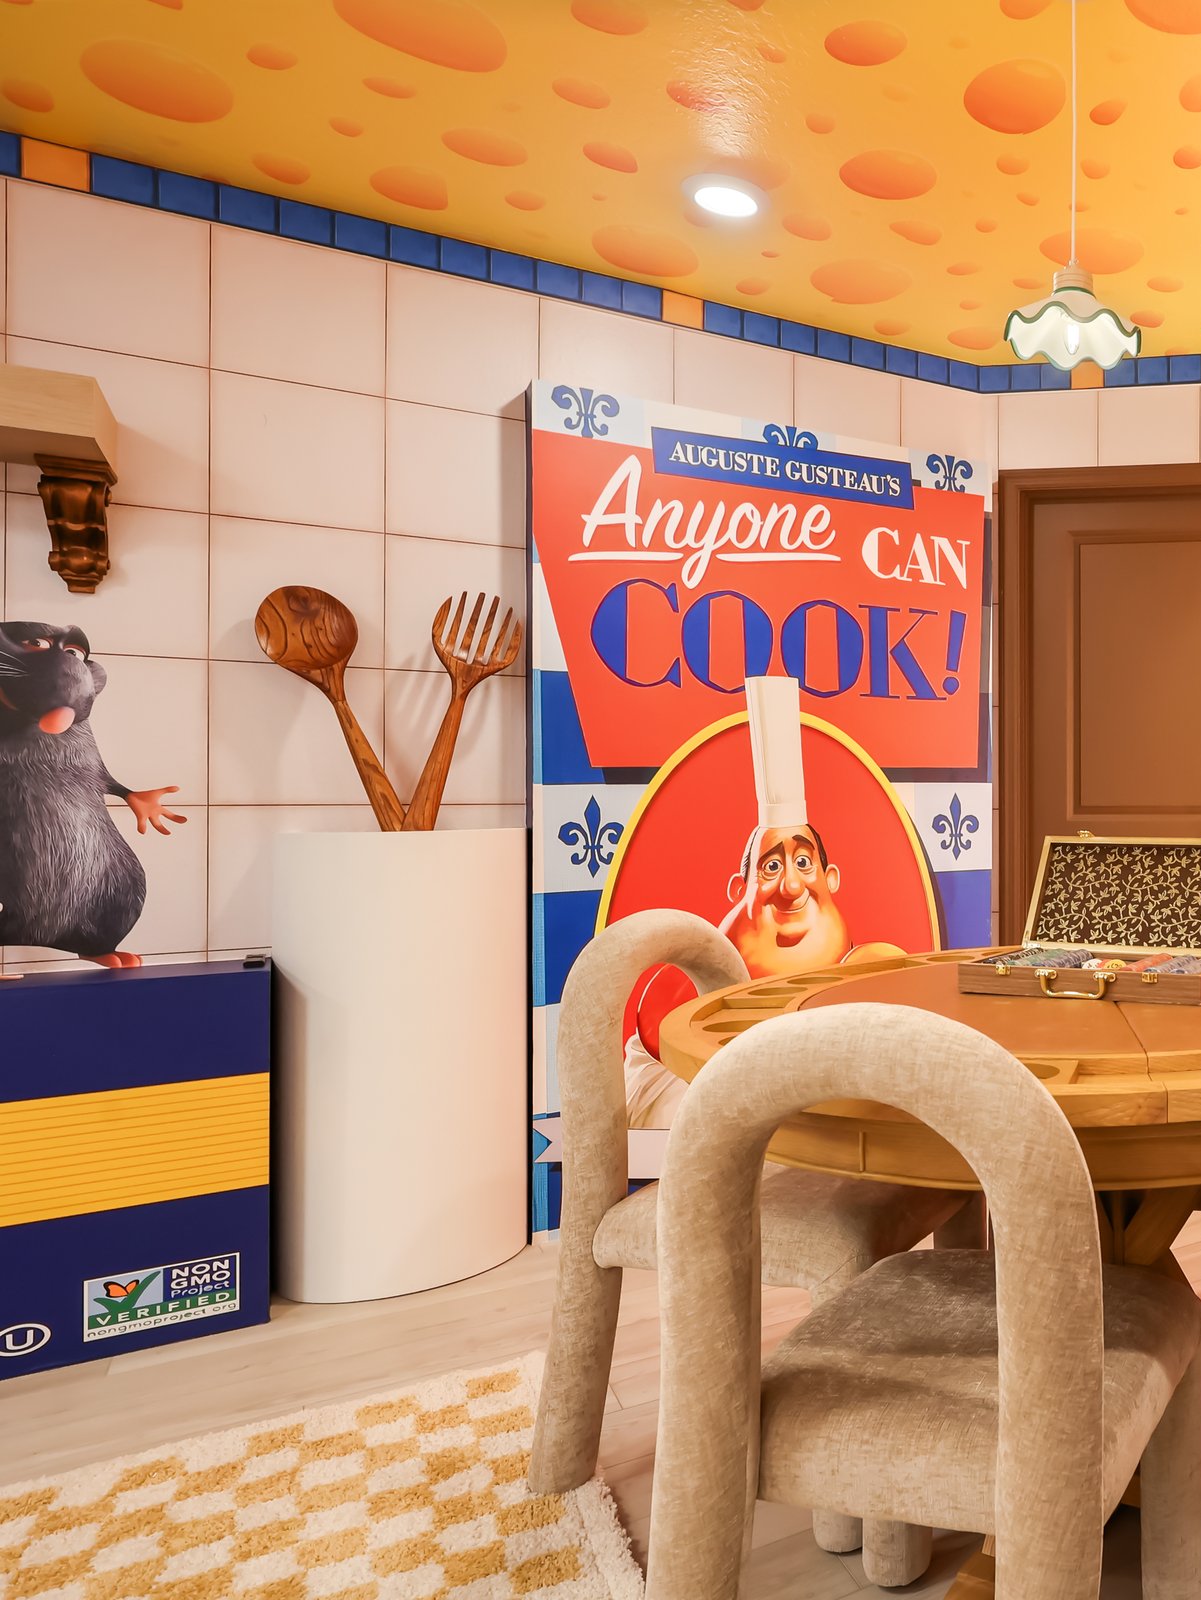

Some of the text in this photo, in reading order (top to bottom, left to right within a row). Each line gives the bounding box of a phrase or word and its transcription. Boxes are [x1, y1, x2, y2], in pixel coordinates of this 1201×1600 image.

[668, 441, 901, 497] AUGUSTE GUSTEAU'S
[581, 454, 970, 589] Anyone CAN
[590, 578, 967, 701] COOK!
[171, 1271, 231, 1289] GMO
[172, 1259, 230, 1279] NON
[171, 1281, 230, 1298] Project
[96, 1292, 230, 1326] VERIFIED
[5, 1329, 34, 1350] U
